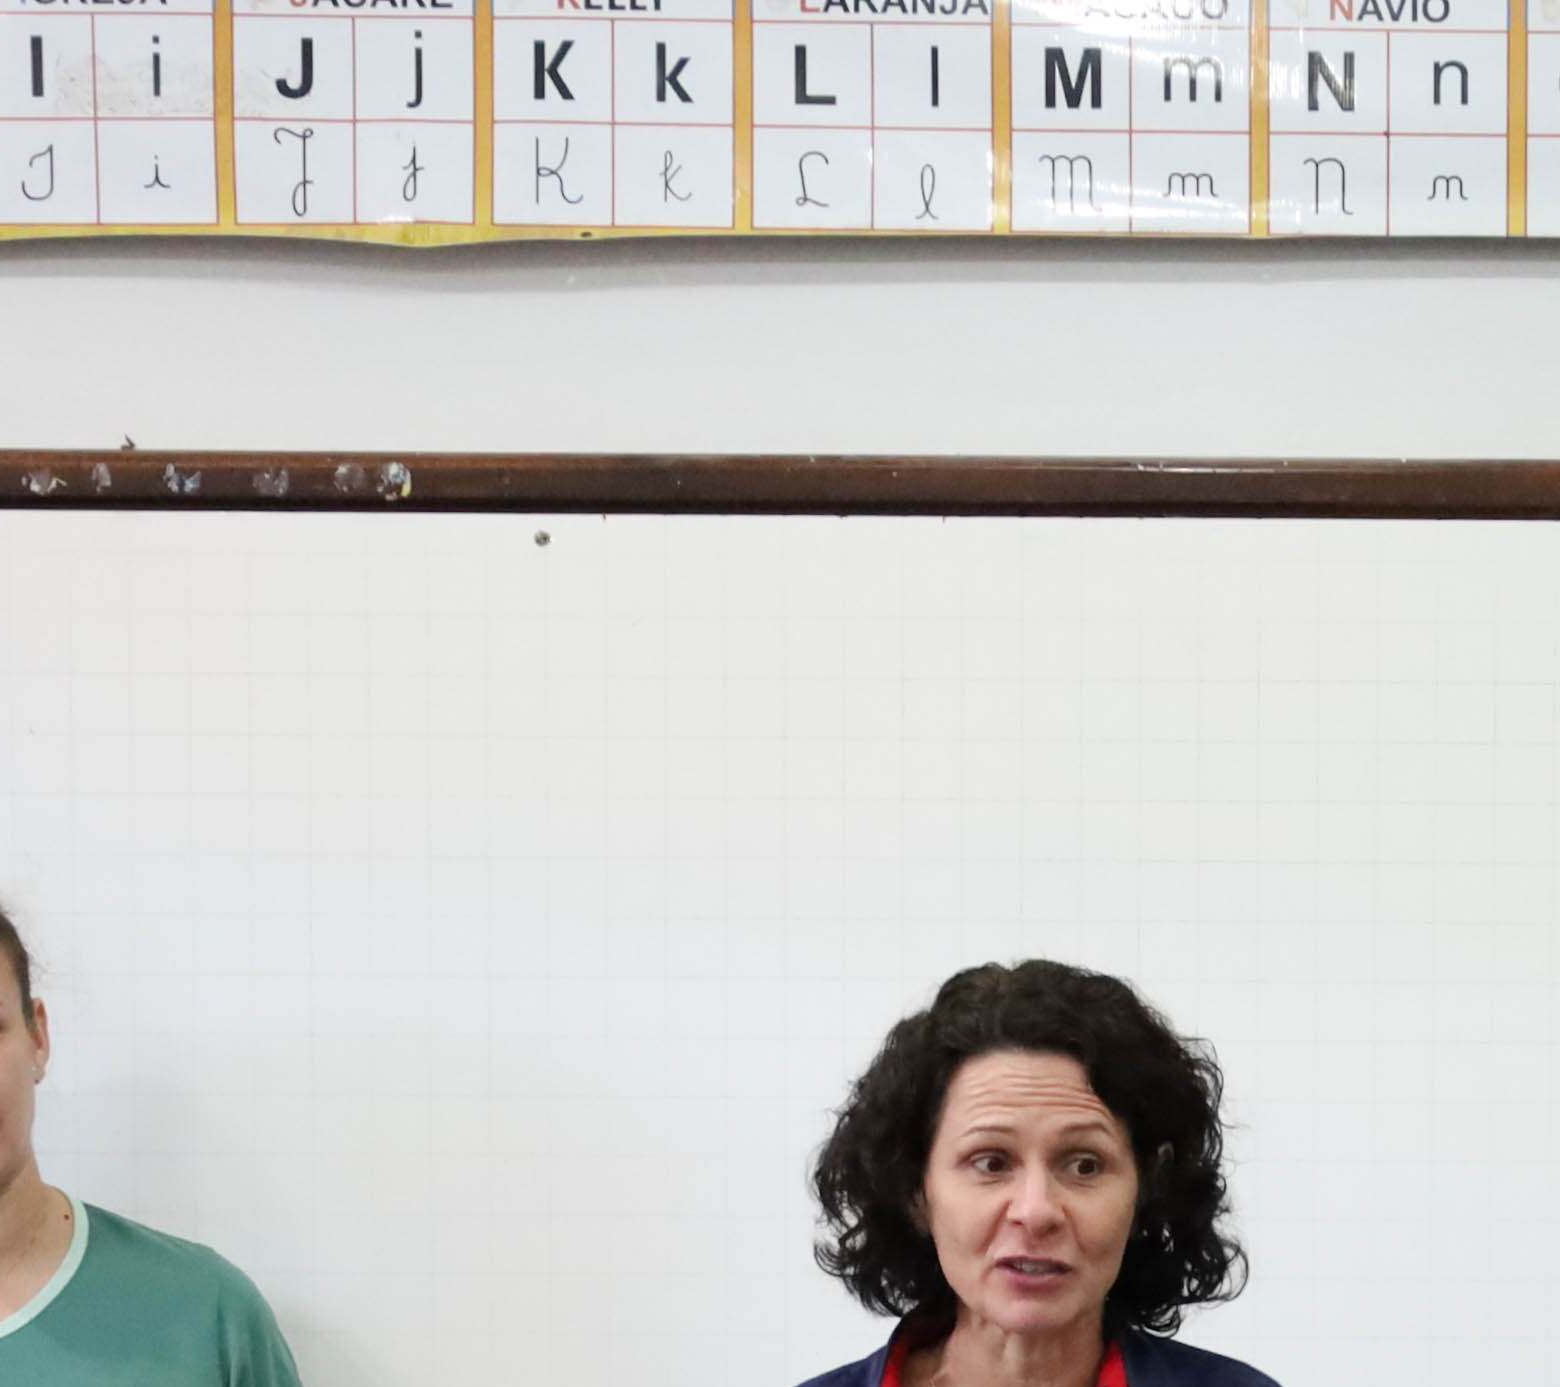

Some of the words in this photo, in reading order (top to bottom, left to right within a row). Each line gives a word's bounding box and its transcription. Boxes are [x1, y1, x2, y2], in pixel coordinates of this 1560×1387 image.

[31, 36, 43, 97] I
[276, 38, 313, 99] J
[534, 41, 574, 100] K
[656, 42, 693, 103] k
[795, 45, 836, 105] L
[1045, 48, 1101, 109] M
[1308, 51, 1354, 112] N
[1434, 61, 1468, 105] n
